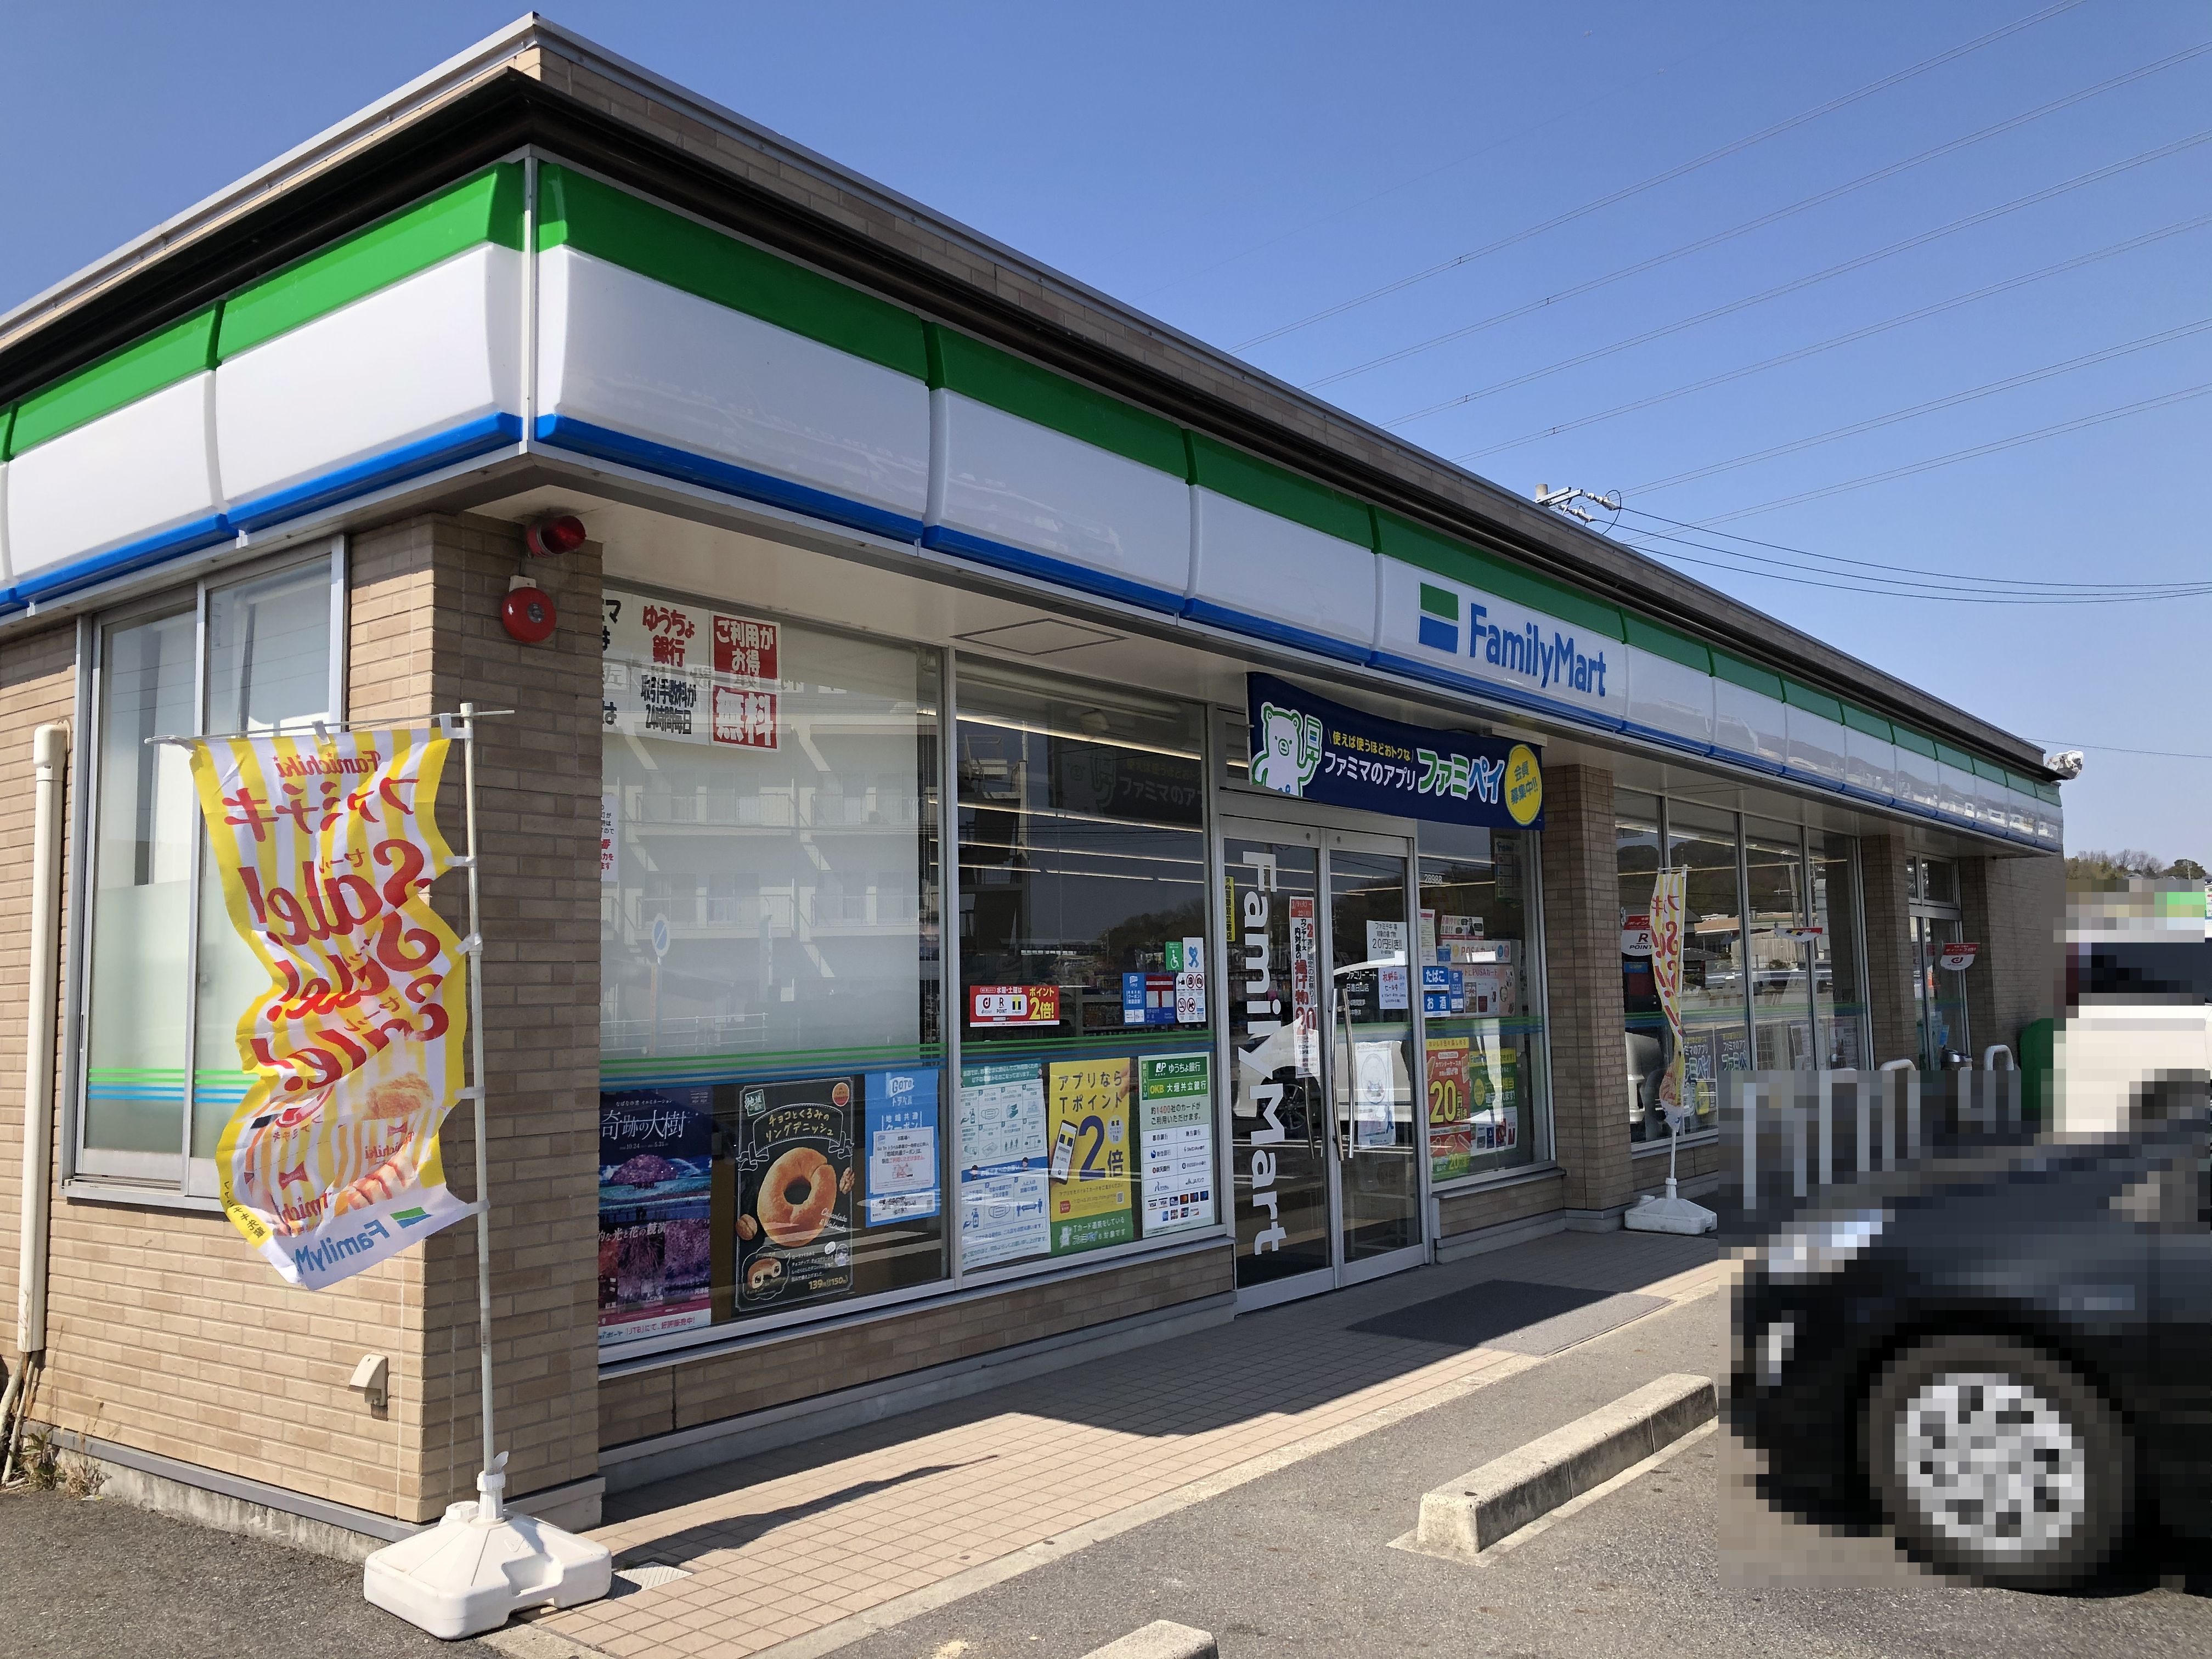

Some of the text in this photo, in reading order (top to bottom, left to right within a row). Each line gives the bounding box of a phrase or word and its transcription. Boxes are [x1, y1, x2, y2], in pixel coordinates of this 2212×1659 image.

[642, 605, 695, 638] ゆうちょ
[716, 620, 774, 651] ご利用が
[653, 635, 685, 667] 銀行
[1469, 603, 1606, 697] FamilyMart
[732, 649, 760, 677] お得
[641, 675, 696, 708] 取引手数料が
[646, 704, 691, 734] 24時間毎日
[716, 688, 774, 746] 無料
[1333, 730, 1410, 761] 使えば使うほどおトクな
[1324, 752, 1416, 791] ファミマのアプリ
[1417, 748, 1505, 804] ファミペイ
[1514, 760, 1530, 782] 会員
[1638, 933, 1649, 942] R
[1295, 959, 1309, 1006] 揚げ物
[1426, 969, 1445, 983] たばこ
[999, 997, 1005, 1008] R
[1029, 987, 1054, 997] ポイント
[1427, 996, 1447, 1010] お酒
[1029, 997, 1054, 1020] 2倍!
[1238, 852, 1290, 1256] FamilyMart
[1169, 1062, 1201, 1074] ゆうちょ銀行
[1059, 1070, 1122, 1091] アプリなら
[1150, 1085, 1164, 1094] OKB
[1167, 1080, 1206, 1093] 大垣共立銀行
[892, 1096, 912, 1107] トラベル
[1059, 1091, 1122, 1114] Tポイント
[1430, 1080, 1457, 1123] 20
[601, 1109, 687, 1141] 奇跡の大樹
[769, 1107, 830, 1127] チョコとくるみの
[885, 1111, 918, 1123] 地域共通
[765, 1120, 834, 1142] リングデニッシュ
[821, 1207, 848, 1222] Chocolate
